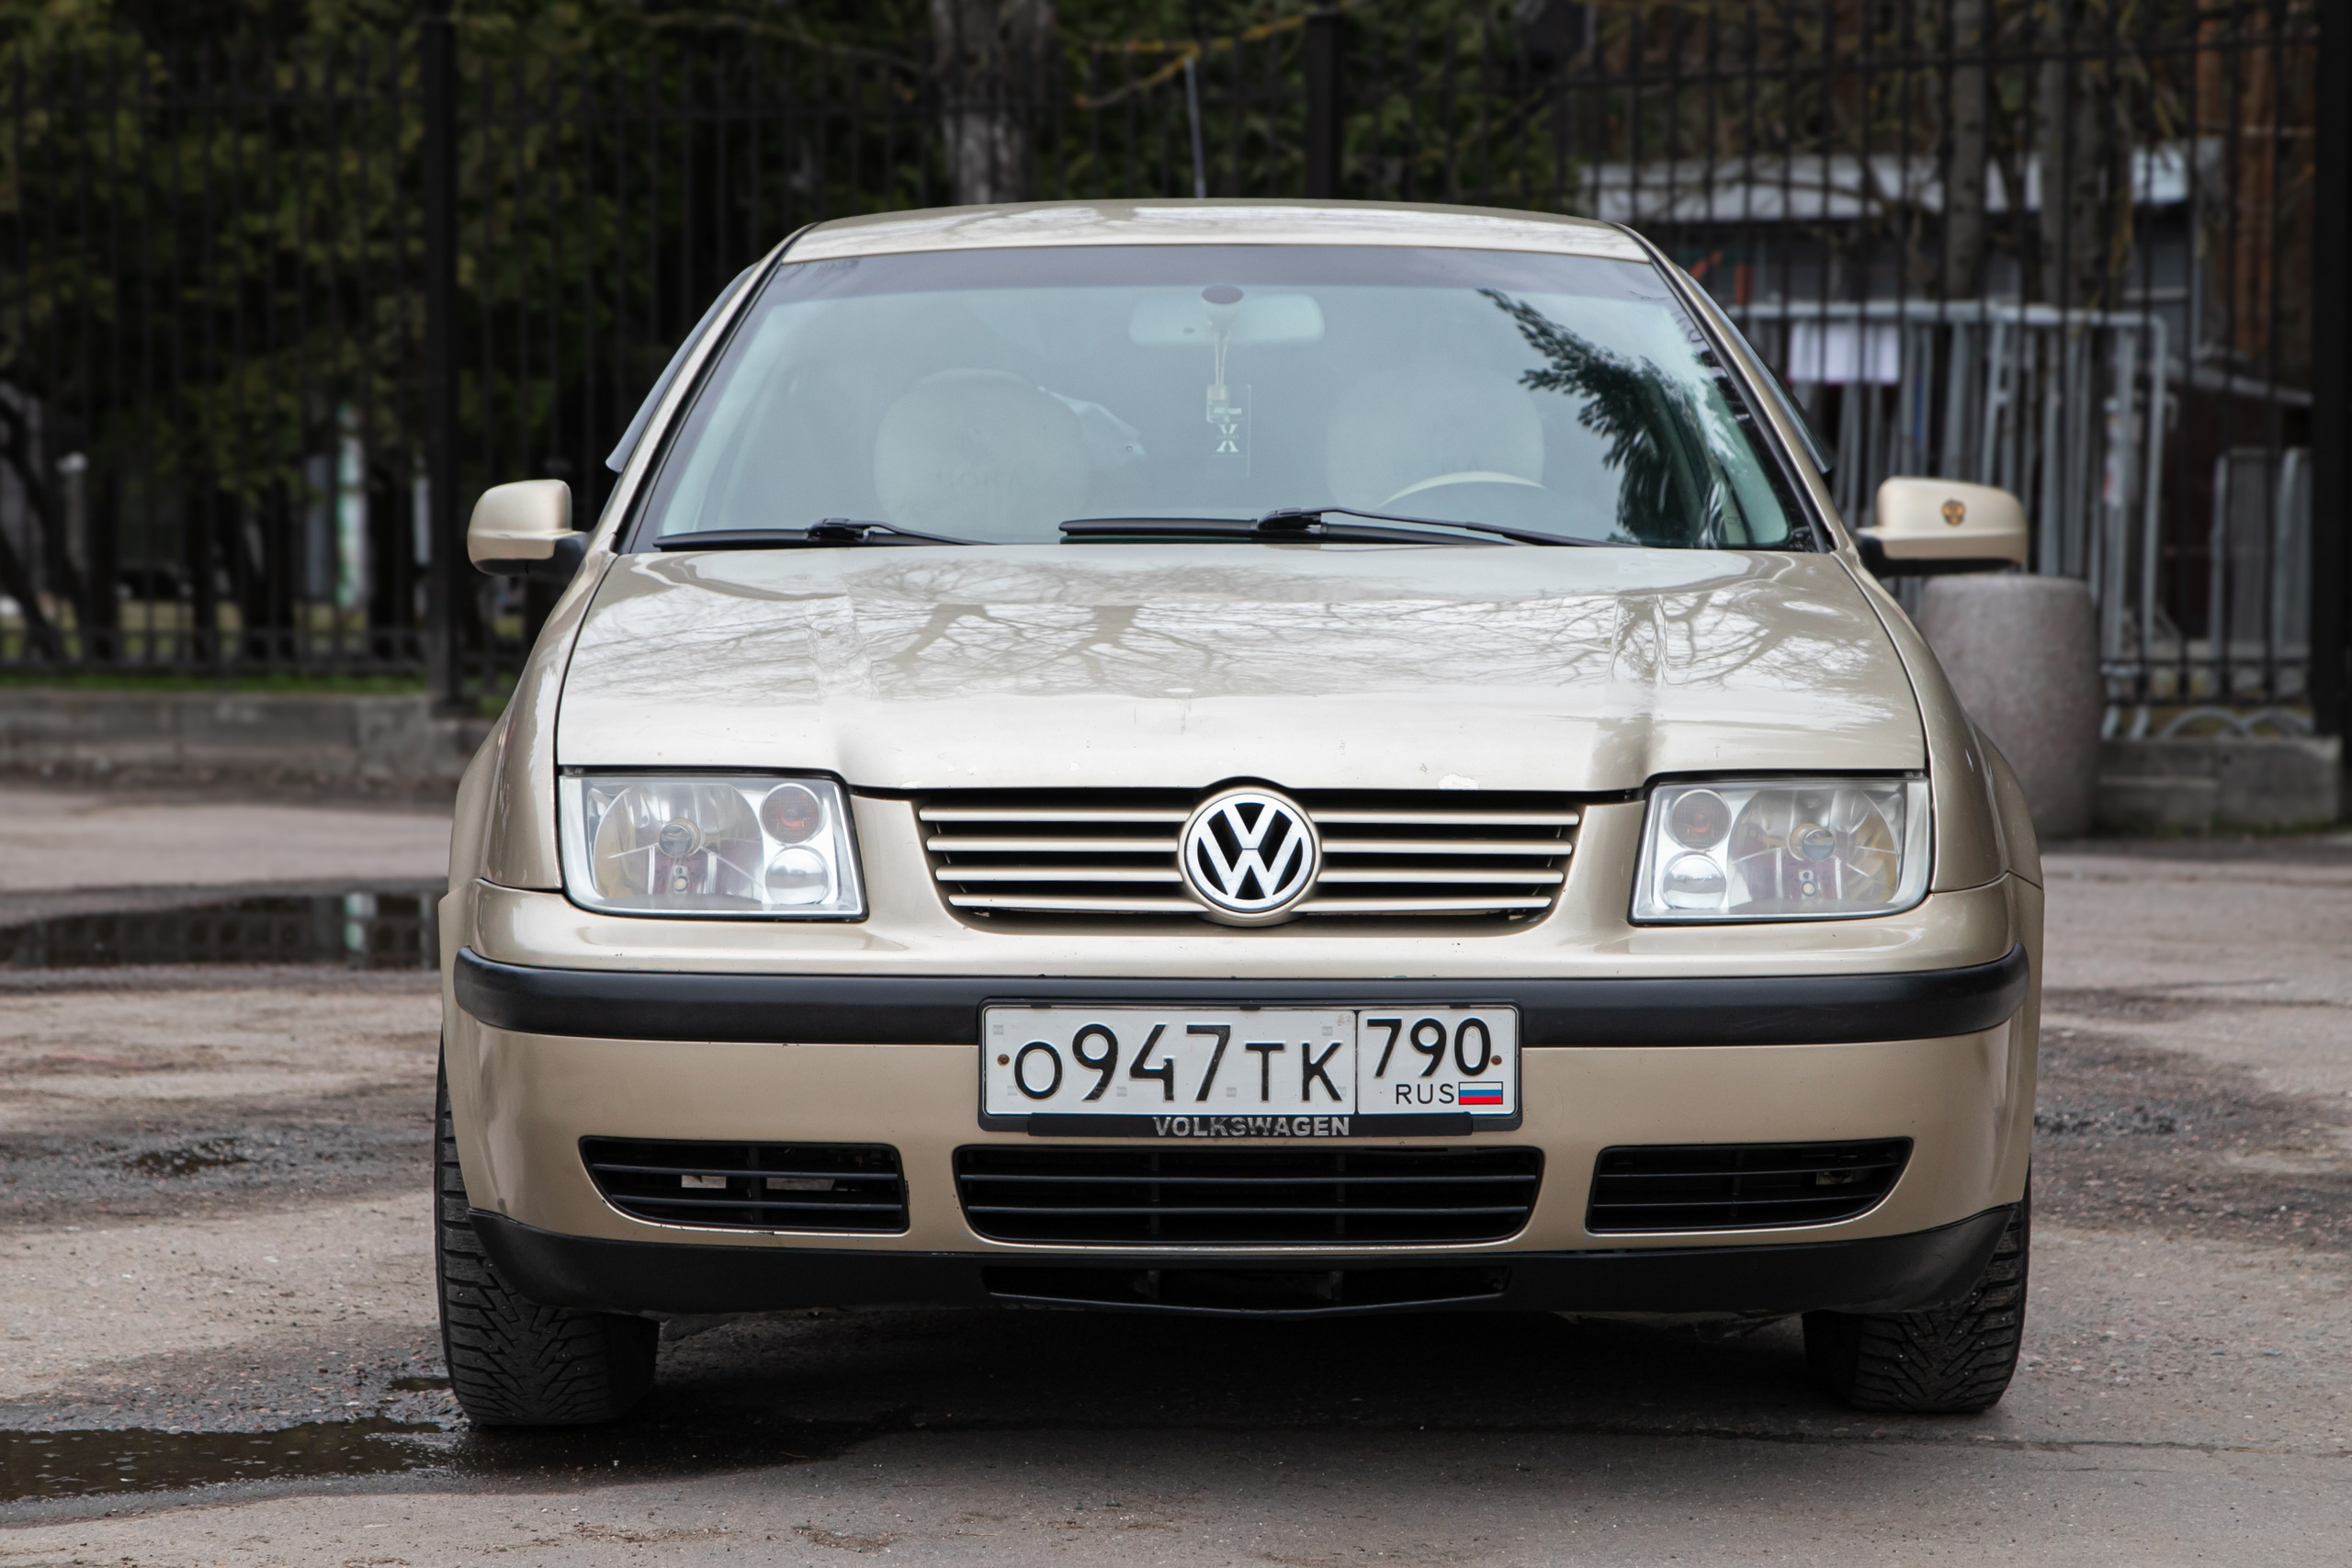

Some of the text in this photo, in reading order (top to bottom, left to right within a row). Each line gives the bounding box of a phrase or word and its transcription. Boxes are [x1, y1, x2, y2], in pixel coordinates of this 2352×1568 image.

[1187, 794, 1312, 908] VW
[1367, 1018, 1491, 1077] 790
[1396, 1084, 1455, 1105] RUS
[1152, 1117, 1351, 1136] VOLKSWAGEN
